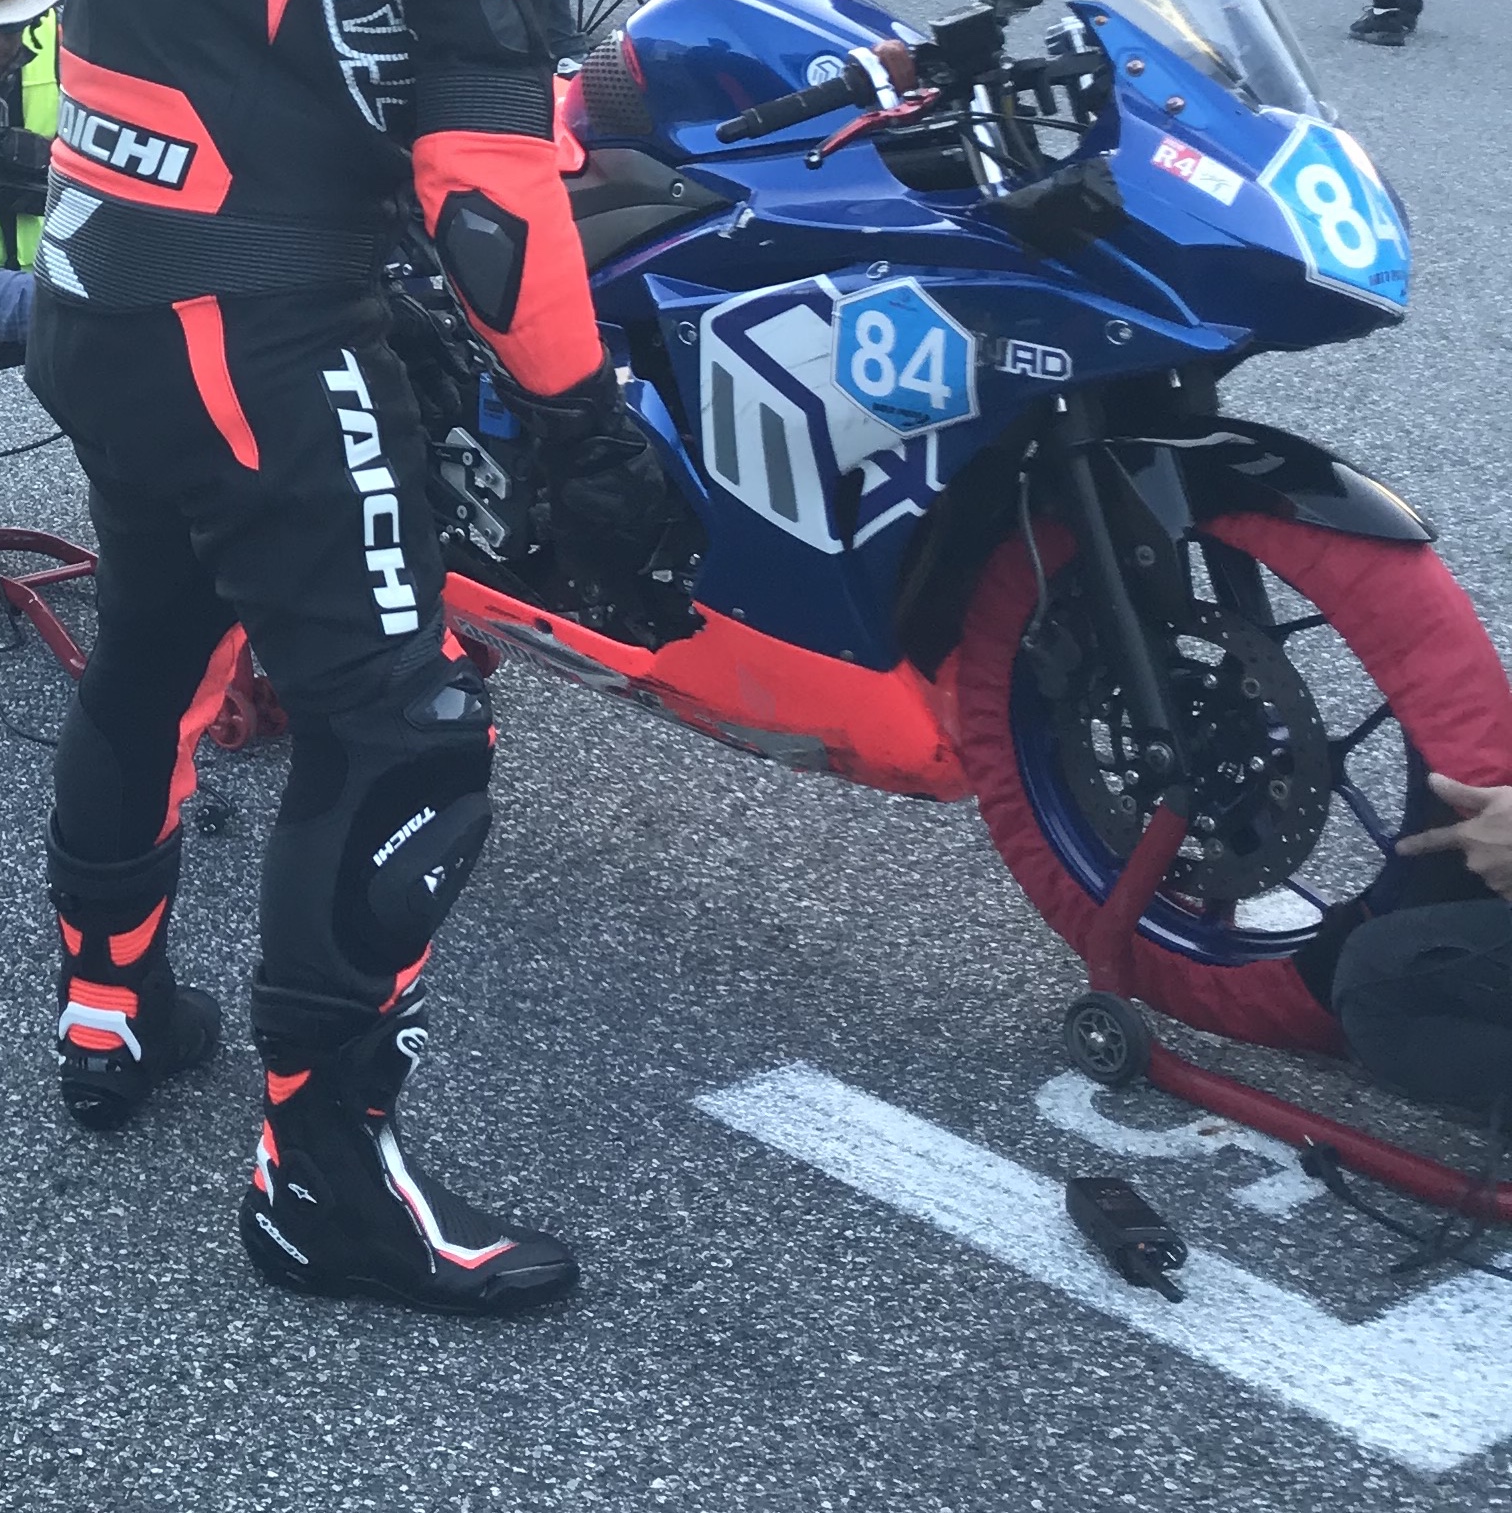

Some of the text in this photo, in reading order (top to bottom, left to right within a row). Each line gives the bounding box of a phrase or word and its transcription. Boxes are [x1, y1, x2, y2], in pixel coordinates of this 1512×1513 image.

[59, 100, 190, 185] AICHI
[1294, 164, 1408, 269] 84
[850, 309, 952, 400] 84
[322, 348, 419, 635] TAICHI
[372, 806, 436, 867] TAICHI
